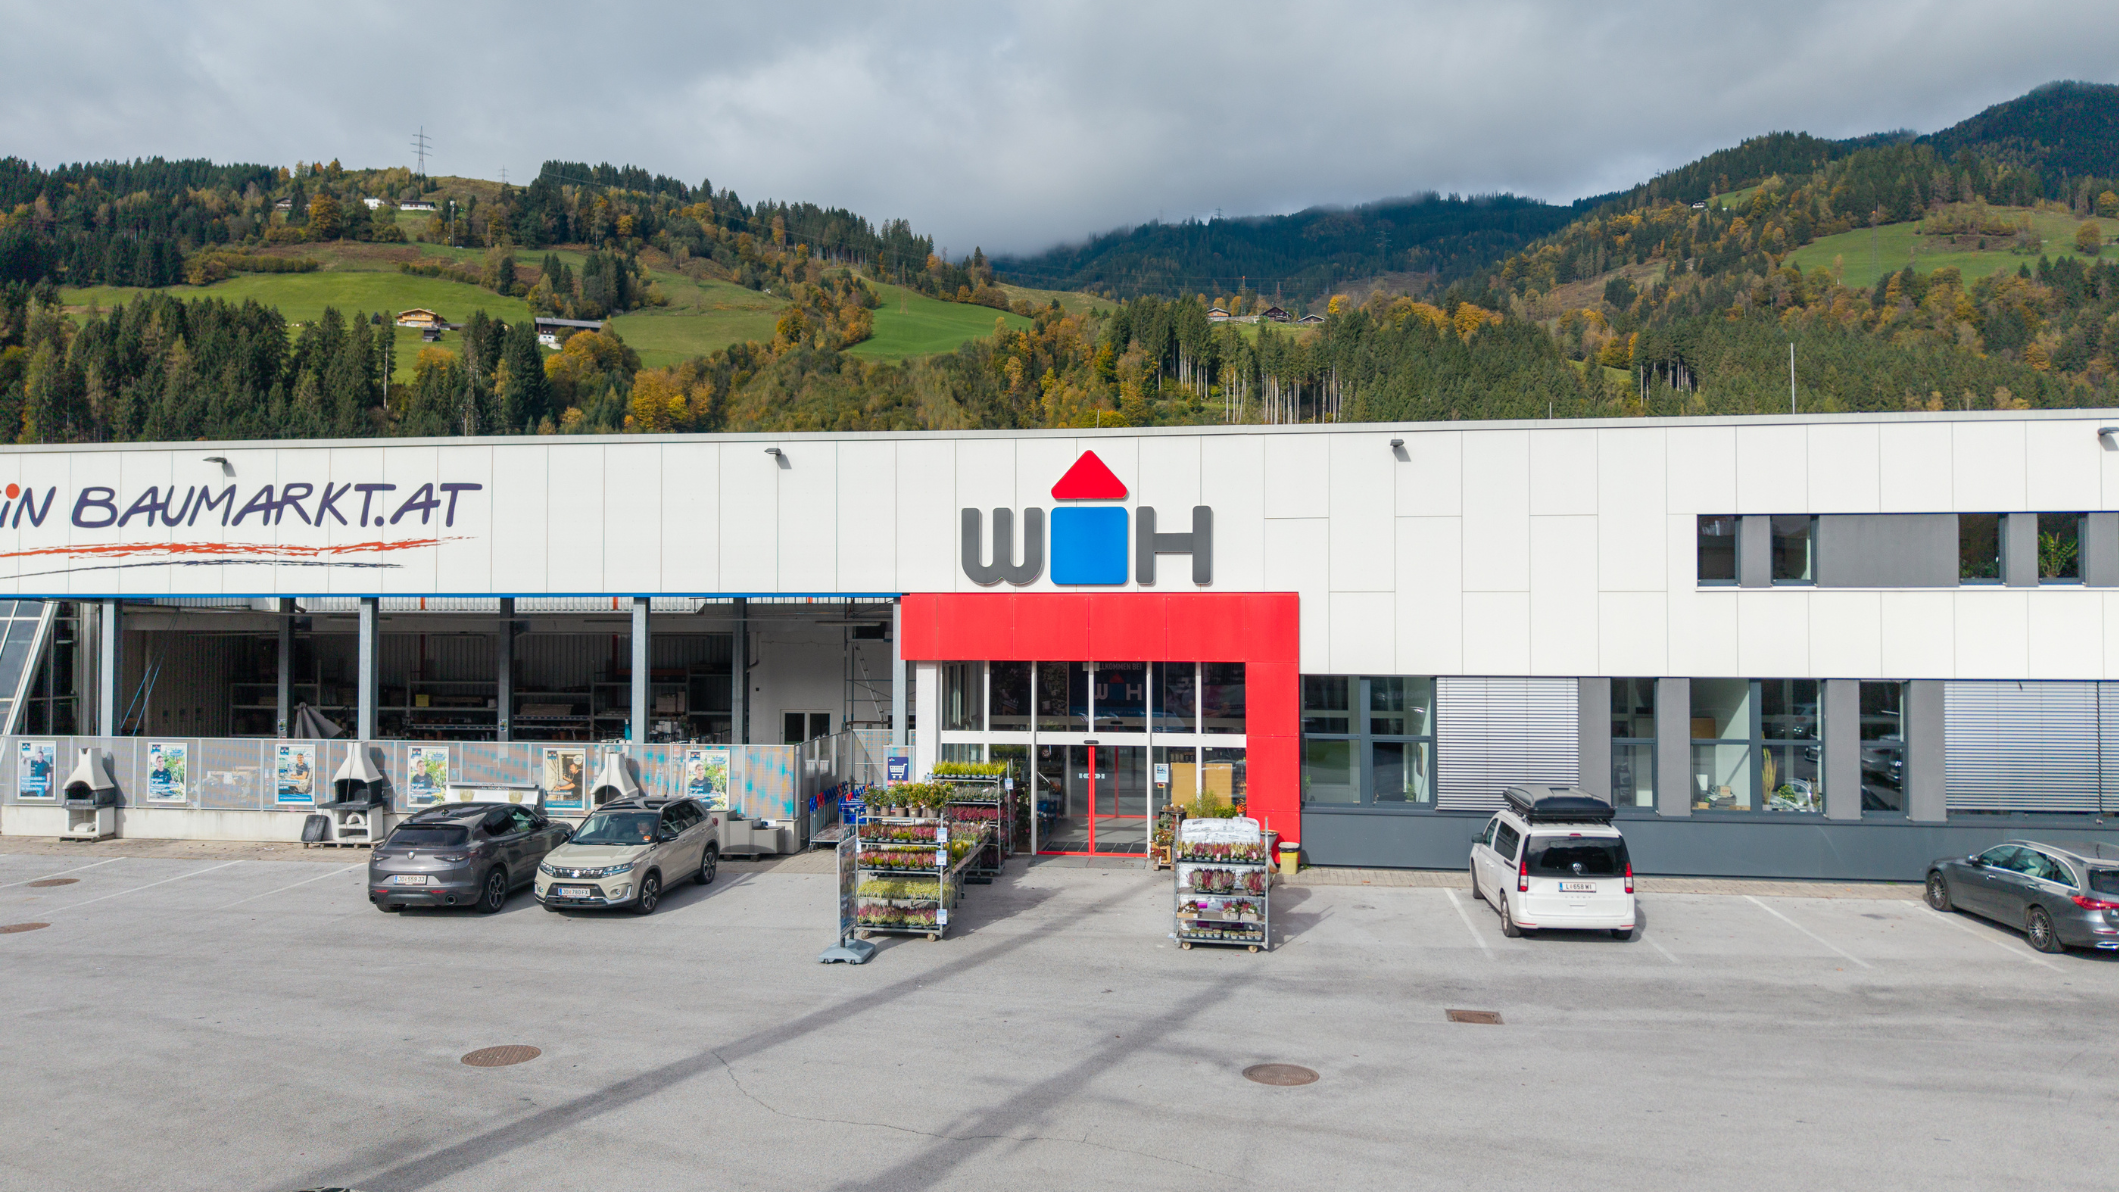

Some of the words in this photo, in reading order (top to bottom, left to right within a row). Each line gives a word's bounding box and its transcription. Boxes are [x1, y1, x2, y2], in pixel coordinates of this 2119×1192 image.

[0, 483, 57, 530] iN
[71, 481, 483, 529] BAUMARKT.AT
[1132, 662, 1142, 671] BEI
